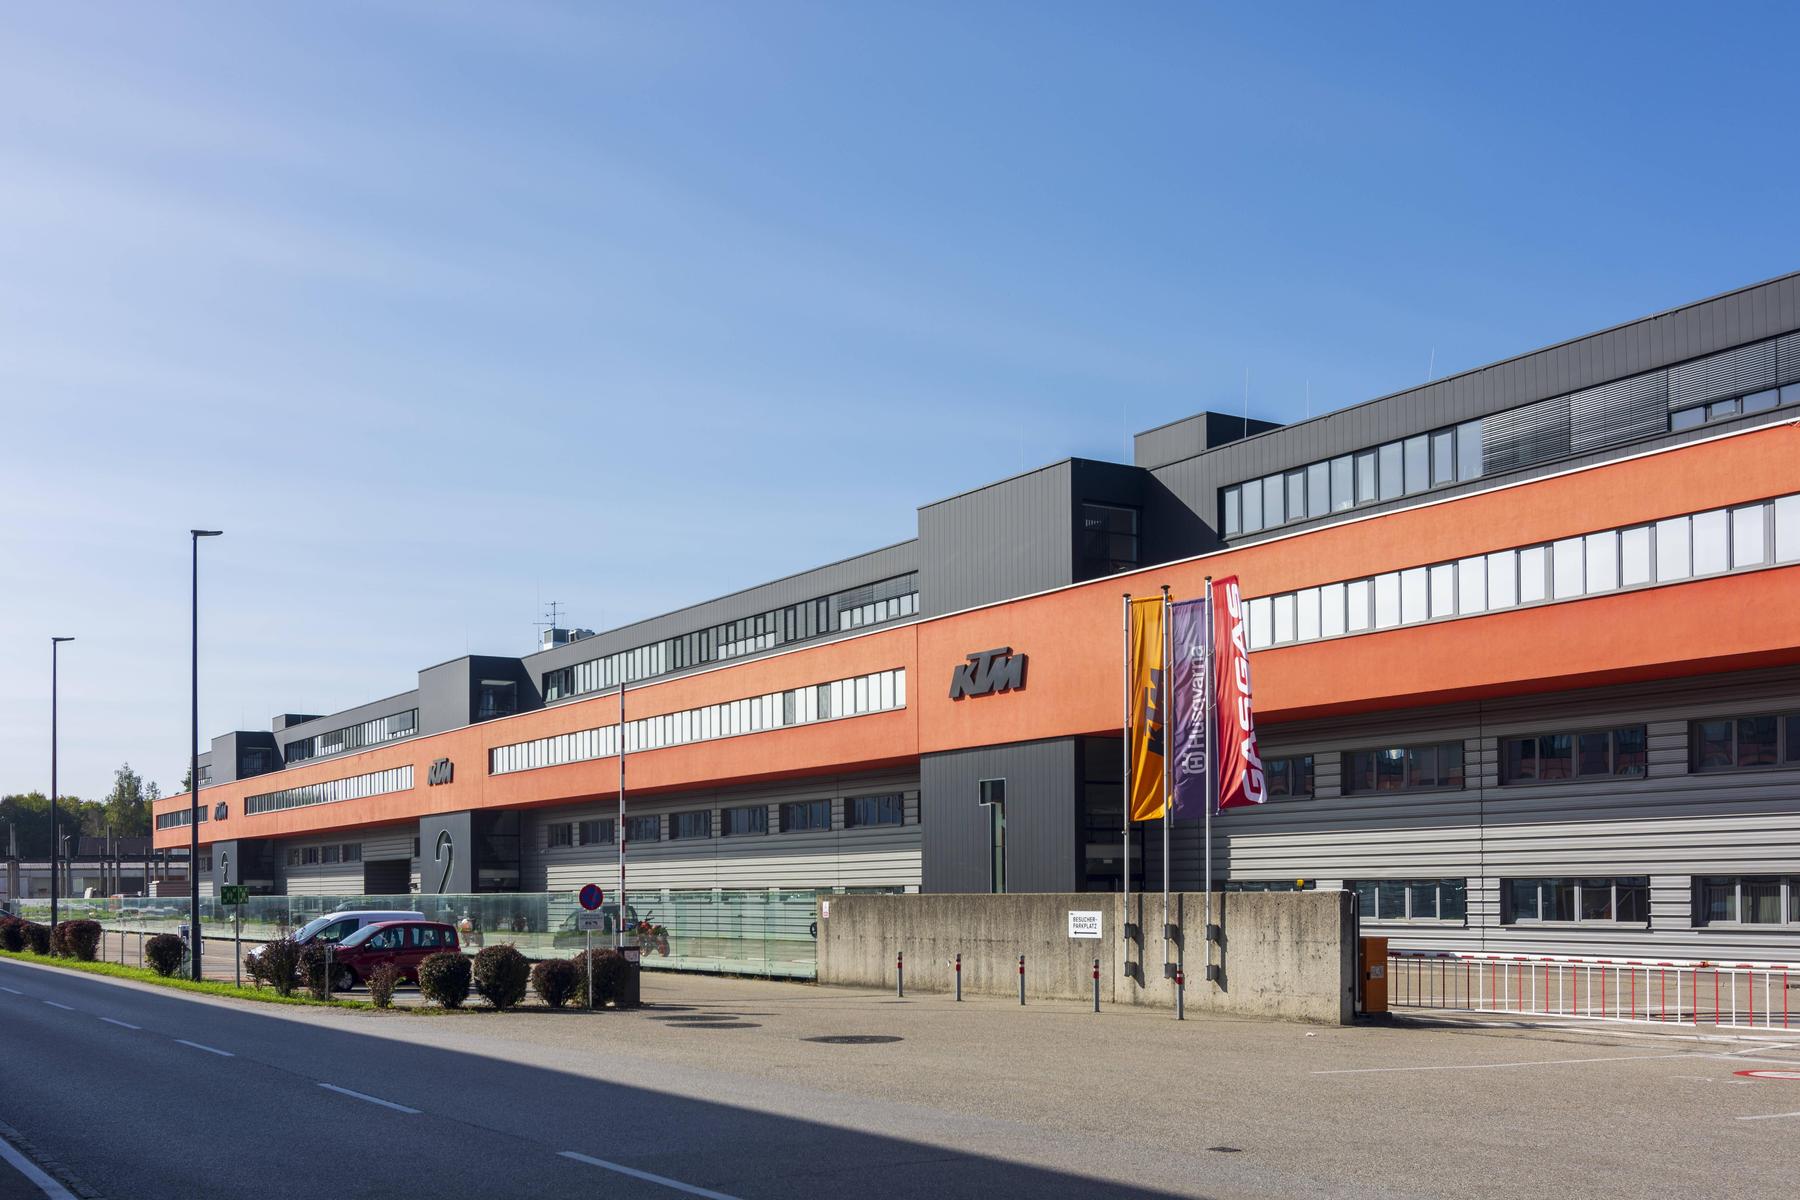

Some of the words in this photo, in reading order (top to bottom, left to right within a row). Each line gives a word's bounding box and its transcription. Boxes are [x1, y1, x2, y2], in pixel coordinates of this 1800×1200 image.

[949, 647, 1026, 699] KTM
[1190, 646, 1206, 748] Husqvarna
[1225, 583, 1268, 803] GASGAS
[428, 757, 453, 785] KTM
[435, 828, 454, 896] 2
[979, 777, 1007, 894] 1
